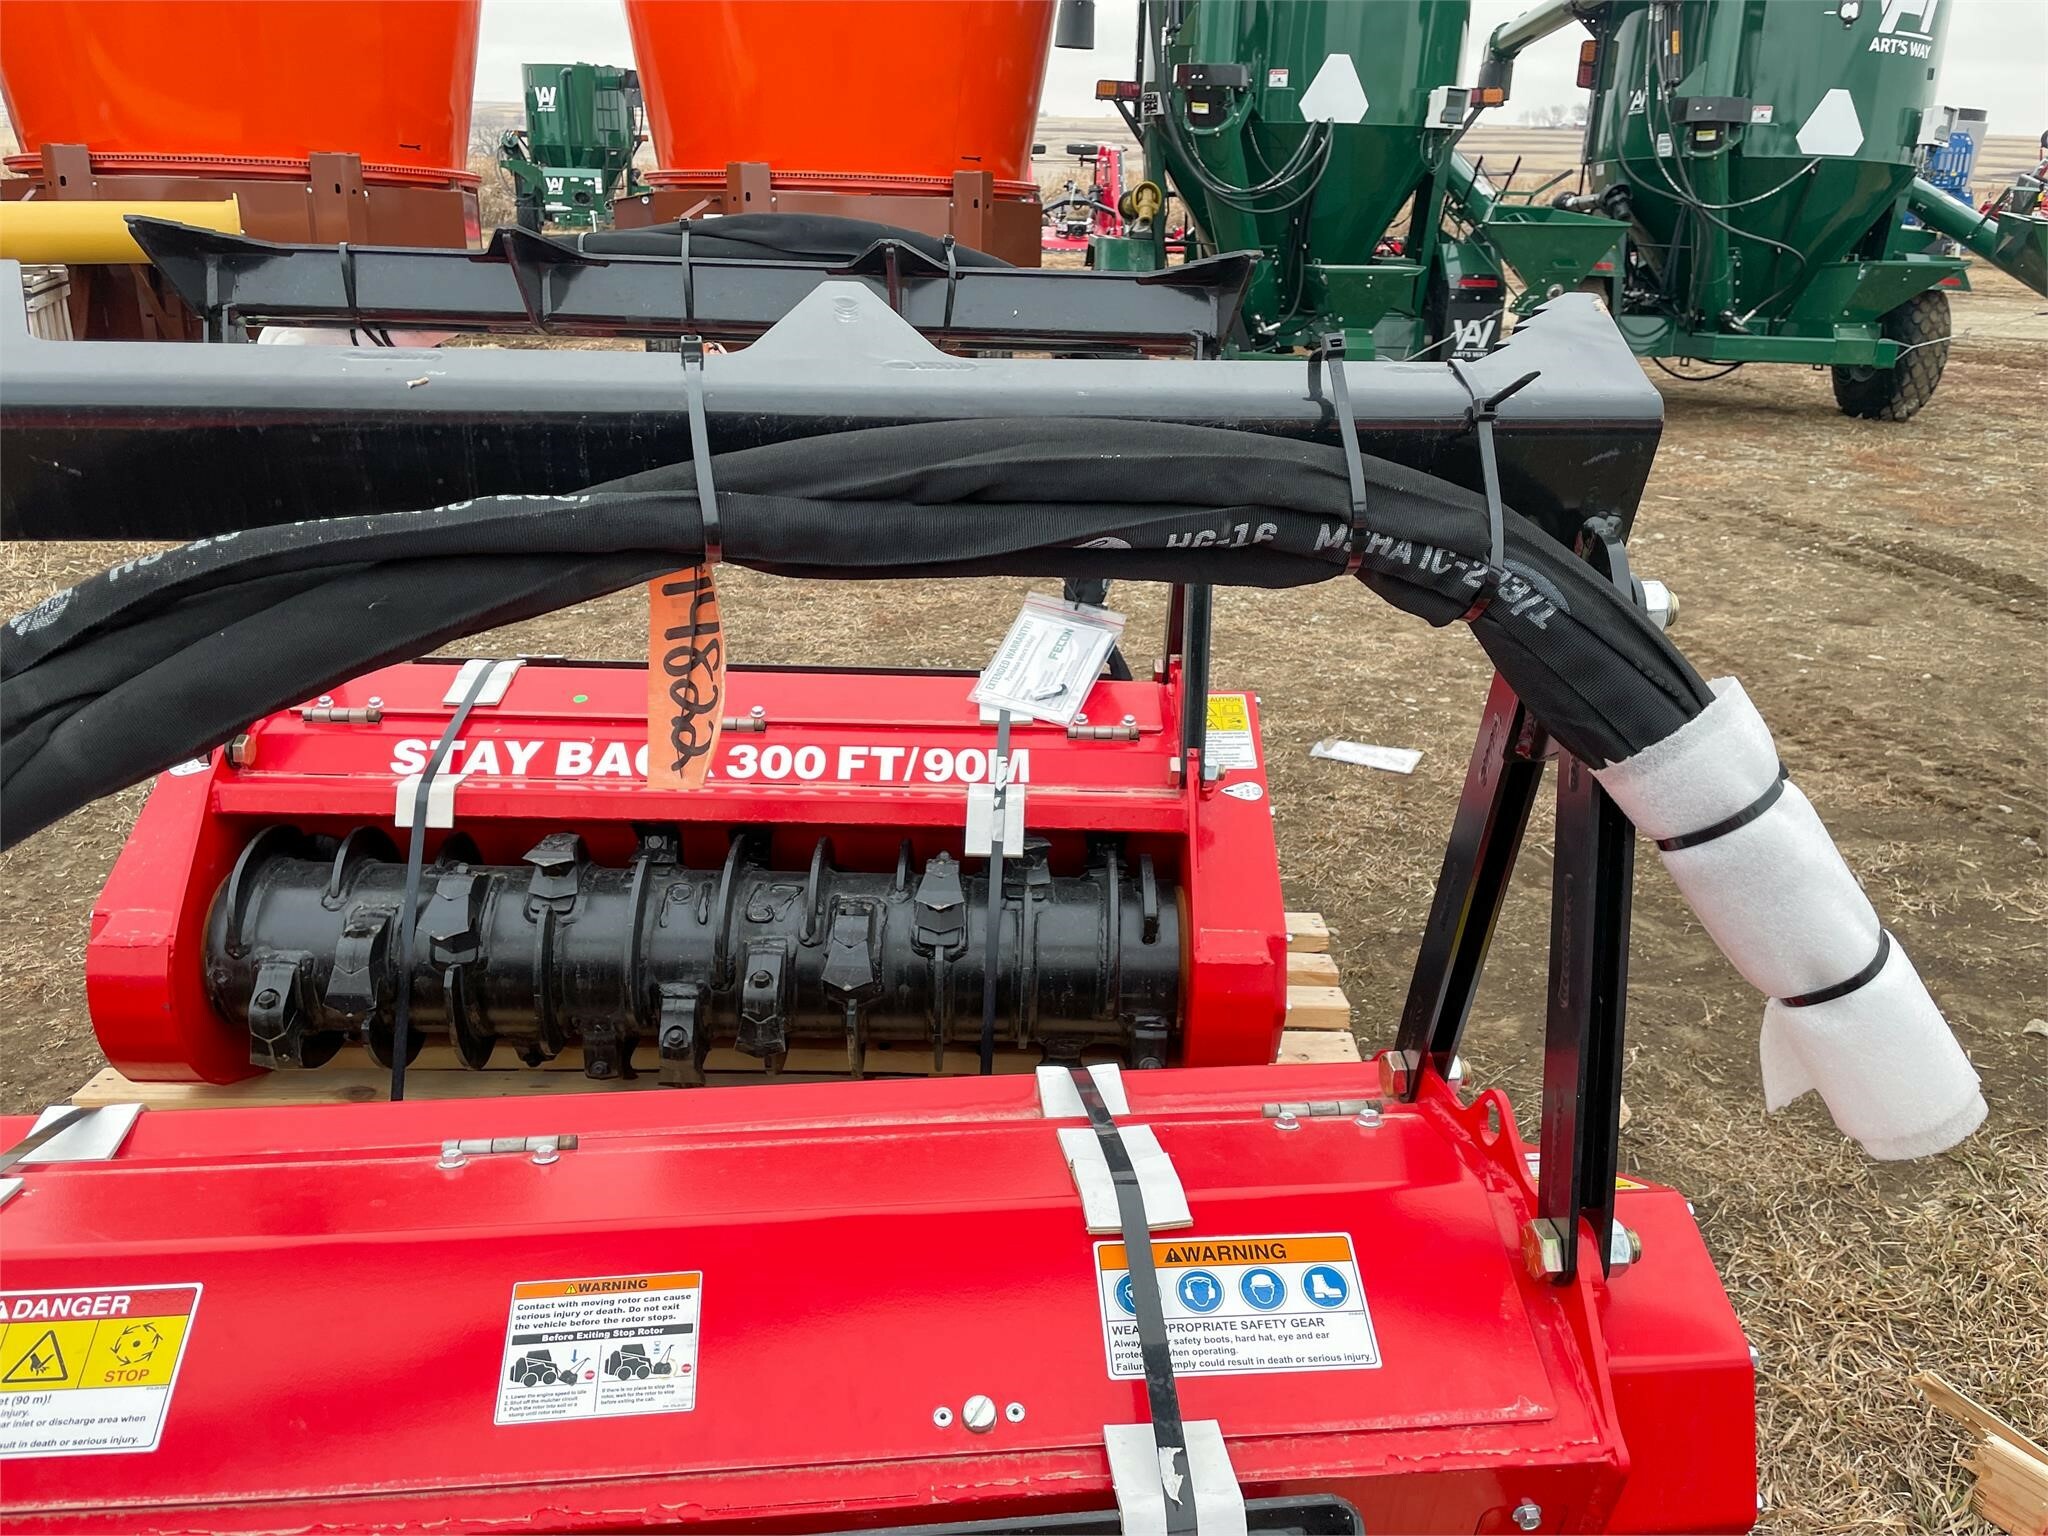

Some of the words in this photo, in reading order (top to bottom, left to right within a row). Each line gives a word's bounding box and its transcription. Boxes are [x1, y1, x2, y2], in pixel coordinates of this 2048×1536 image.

[1868, 37, 1908, 55] ART'S
[1910, 41, 1931, 59] WAY
[1048, 628, 1075, 660] FECON
[986, 659, 1011, 690] EXTENDED
[390, 738, 544, 775] STAY
[726, 744, 827, 780] 300
[837, 746, 1029, 783] FT/90M
[1181, 1243, 1287, 1263] WARNING
[578, 1279, 648, 1293] WARNING
[11, 1295, 132, 1319] DANGER
[516, 1312, 551, 1320] serious
[553, 1310, 581, 1319] injury
[596, 1307, 626, 1315] death.
[662, 1303, 680, 1311] exit
[517, 1302, 555, 1311] Contact
[558, 1300, 579, 1308] with
[581, 1298, 615, 1307] moving
[533, 1321, 567, 1329] vehicle
[570, 1318, 601, 1327] before
[621, 1315, 646, 1323] rotor
[647, 1313, 676, 1322] stops.
[1112, 1326, 1139, 1335] WEA
[1164, 1321, 1238, 1333] PROPRIATE
[1240, 1319, 1288, 1330] SAFETY
[1290, 1317, 1325, 1328] GEAR
[541, 1333, 574, 1342] Before
[576, 1330, 611, 1340] Exiting
[612, 1328, 635, 1338] Stop
[637, 1327, 665, 1335] Rotor
[1113, 1340, 1141, 1349] Alway
[1174, 1336, 1202, 1347] safety
[1203, 1335, 1233, 1344] boots,
[1235, 1334, 1256, 1343] hard
[1258, 1333, 1276, 1342] hat,
[1277, 1333, 1294, 1342] eye
[1296, 1332, 1313, 1340] and
[1192, 1347, 1239, 1358] operating.
[1199, 1358, 1225, 1367] could
[1227, 1357, 1255, 1366] result
[1256, 1356, 1265, 1365] in
[1267, 1355, 1293, 1364] death
[1295, 1356, 1305, 1364] or
[1307, 1354, 1342, 1363] serious
[1343, 1353, 1373, 1362] injury.
[104, 1368, 150, 1383] STOP
[11, 1395, 30, 1407] (90
[32, 1394, 52, 1405] m)!
[1, 1409, 30, 1419] injury.
[13, 1420, 34, 1428] inlet
[48, 1416, 96, 1428] discharge
[97, 1416, 119, 1424] area
[120, 1414, 147, 1423] when
[18, 1440, 28, 1448] in
[30, 1439, 57, 1448] death
[72, 1437, 107, 1447] serious
[110, 1435, 140, 1446] injury.
